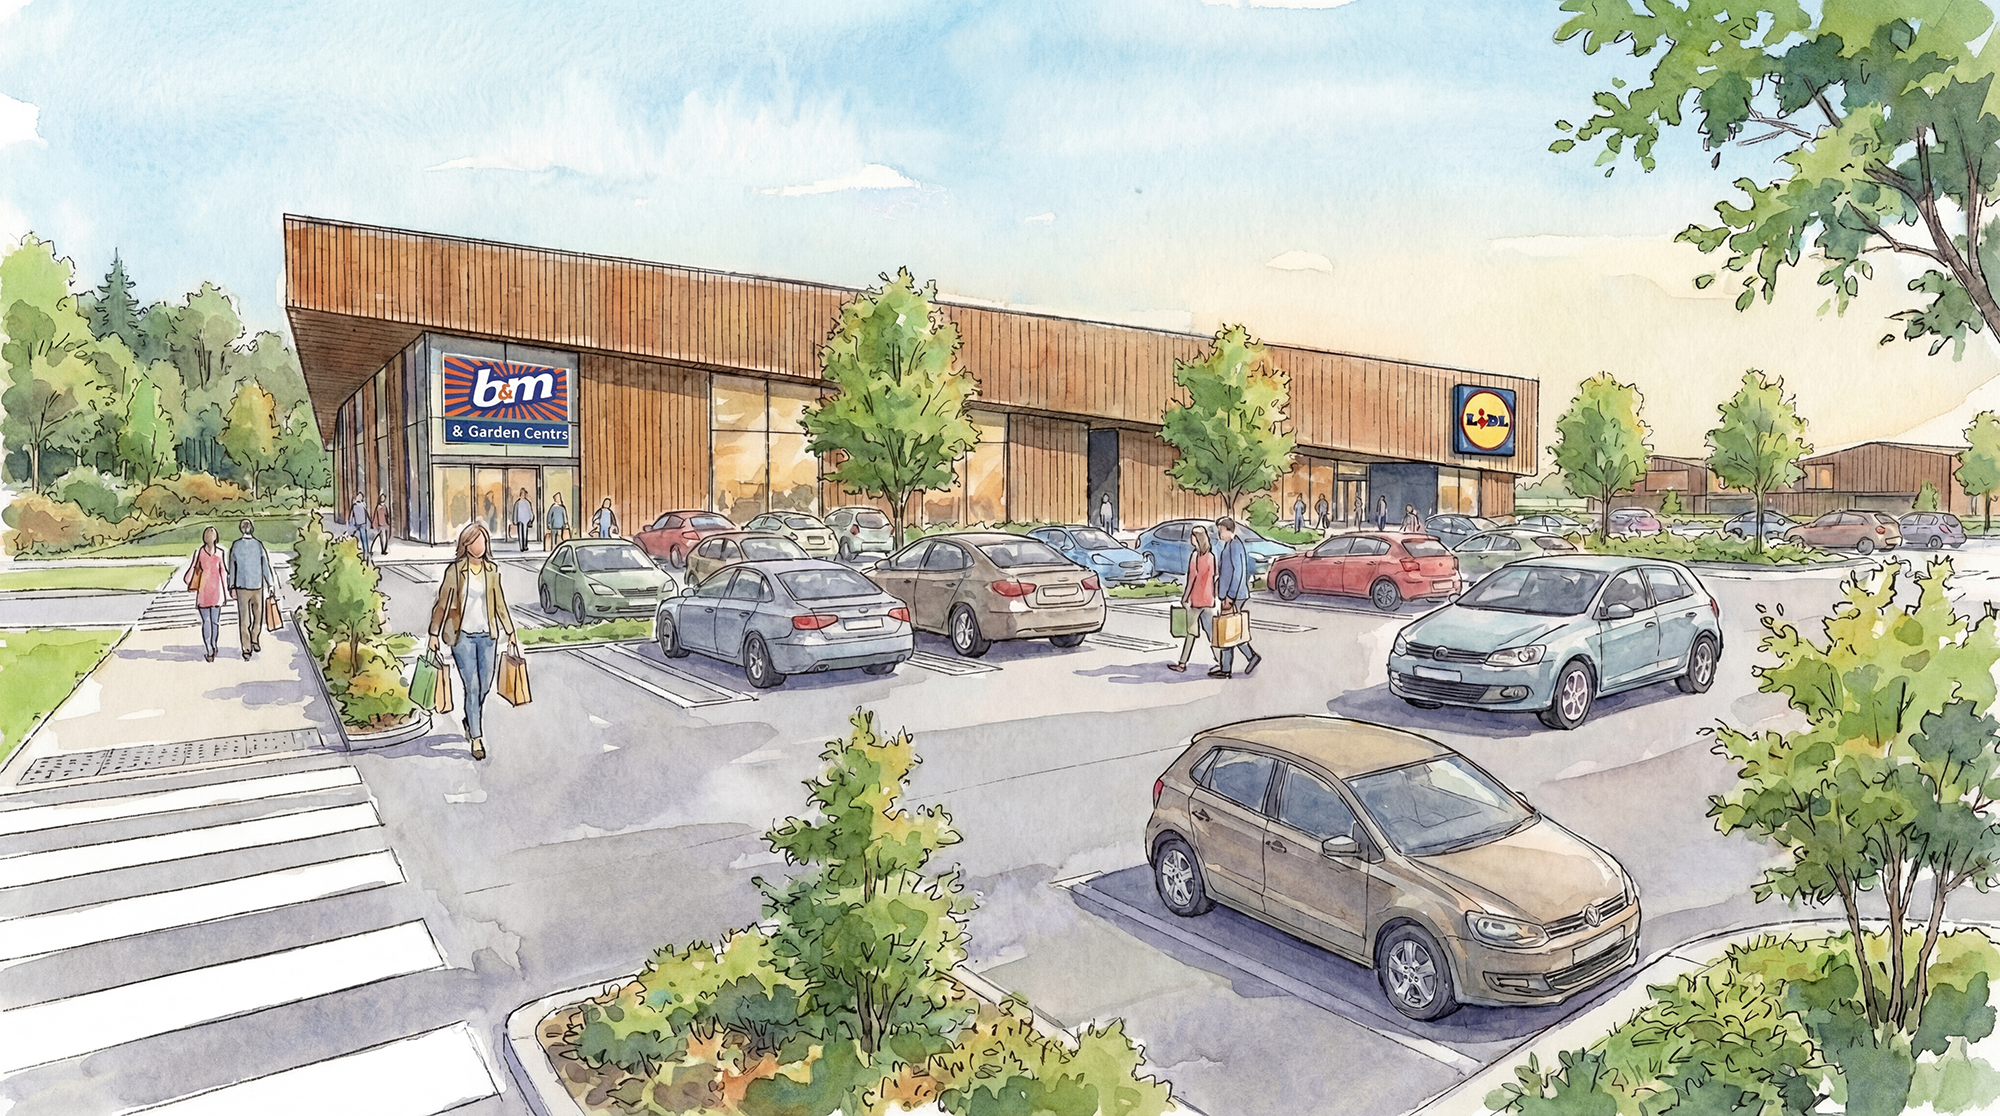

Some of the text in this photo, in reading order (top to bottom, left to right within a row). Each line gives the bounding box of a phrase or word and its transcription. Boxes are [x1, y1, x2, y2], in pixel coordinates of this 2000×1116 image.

[452, 425, 569, 440] & Garden Centrs
